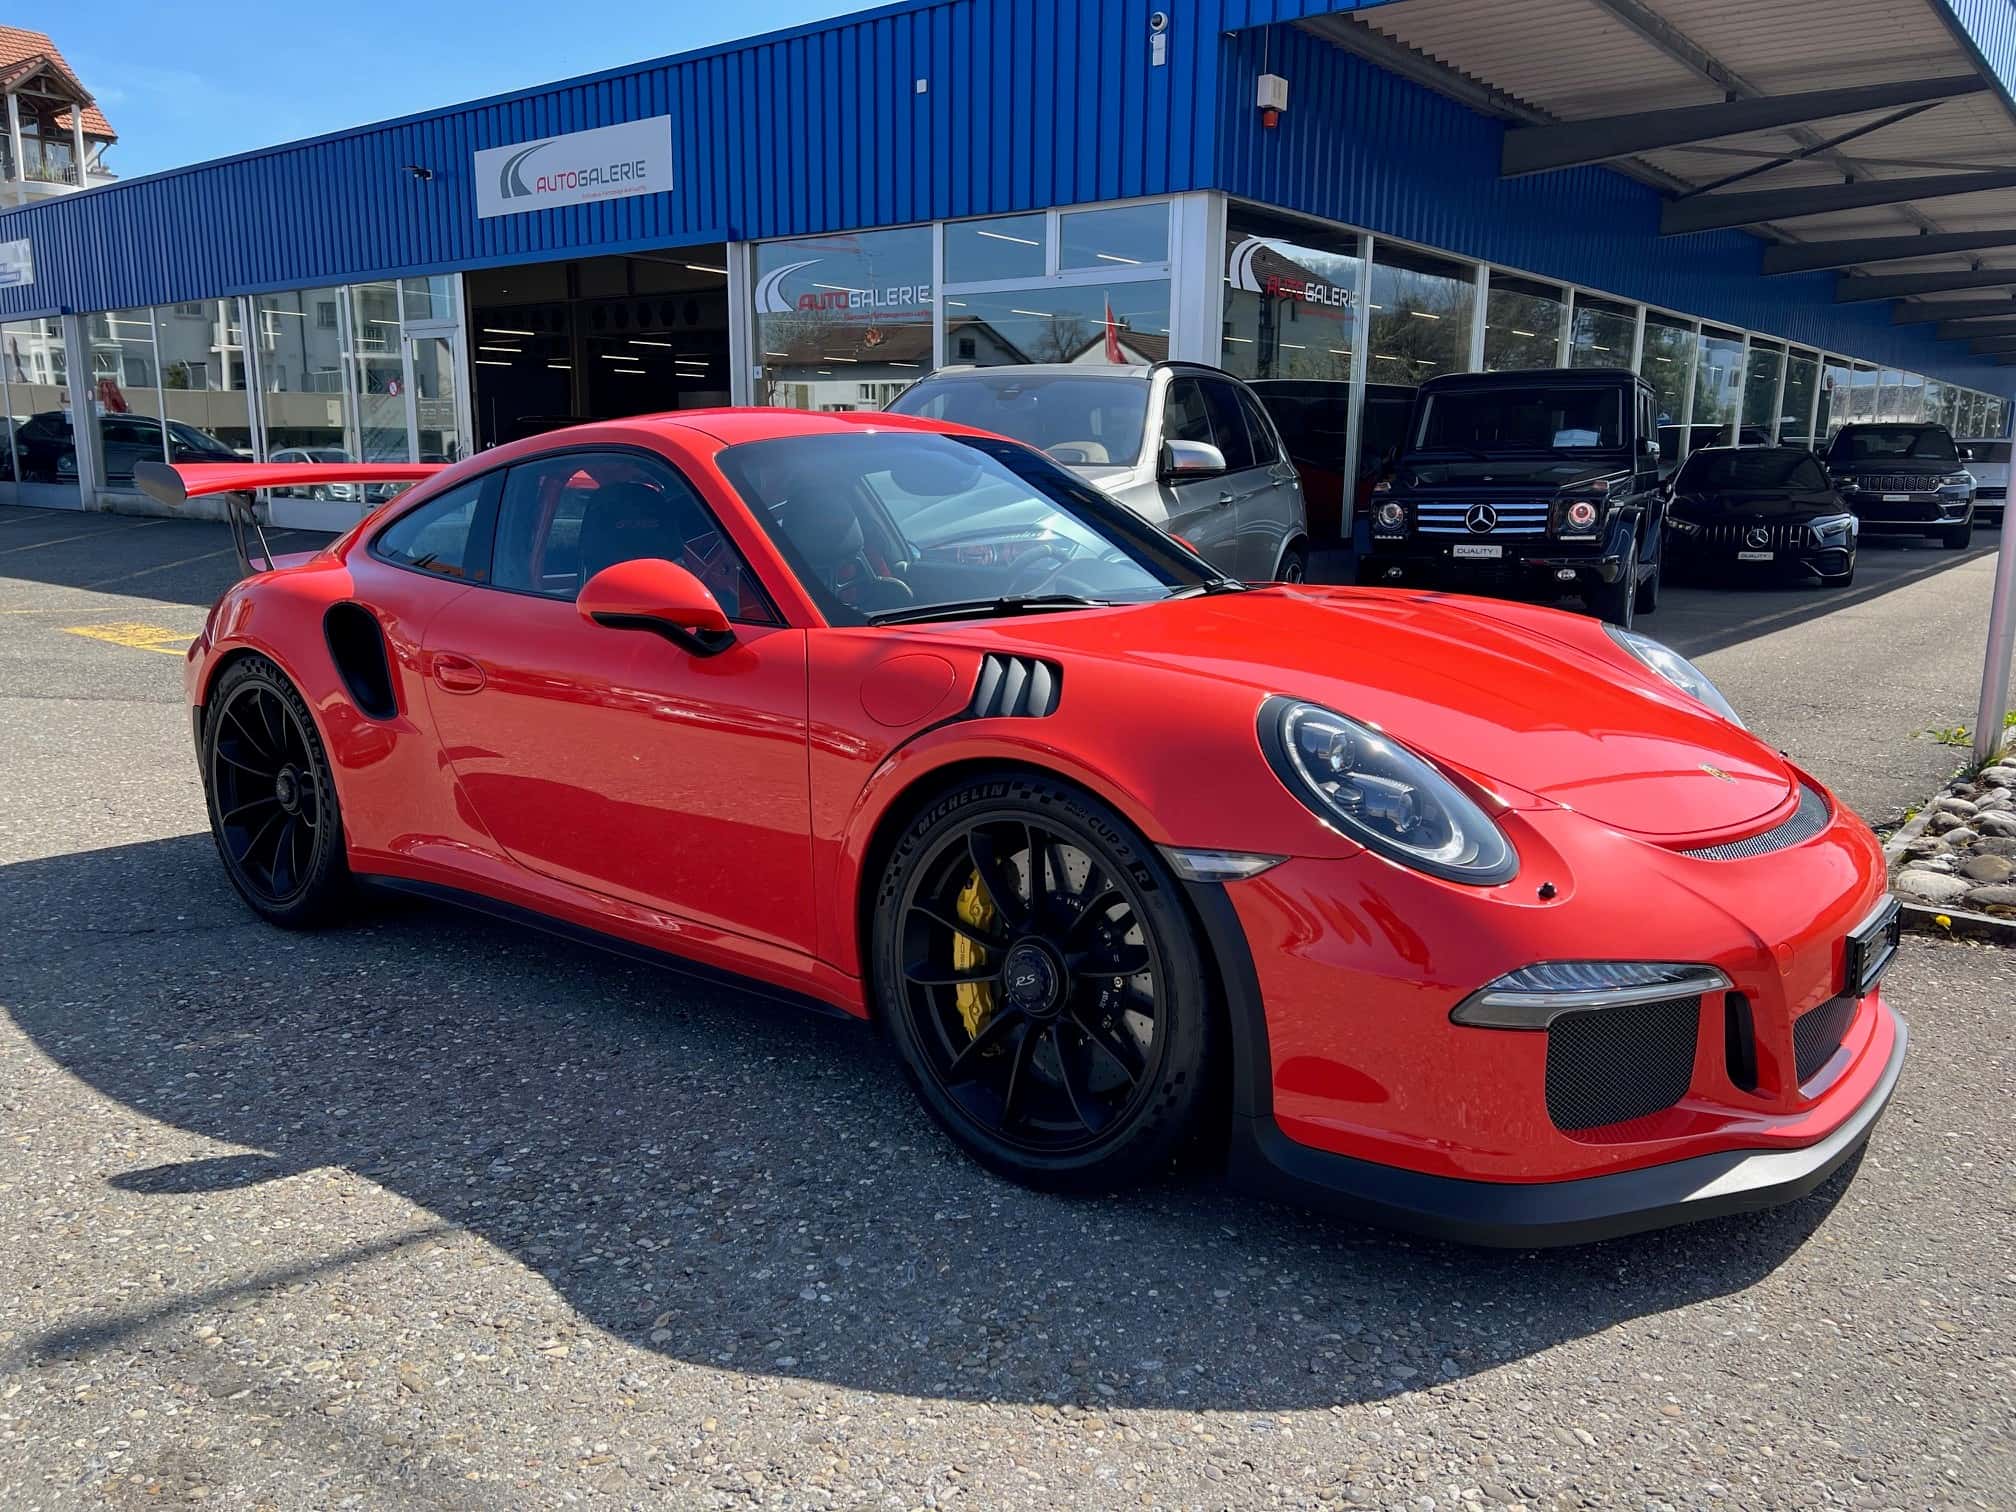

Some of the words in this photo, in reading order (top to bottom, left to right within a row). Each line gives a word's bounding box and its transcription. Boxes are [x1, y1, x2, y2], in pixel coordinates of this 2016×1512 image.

[536, 159, 646, 193] AUTOGALERIE
[799, 285, 930, 312] AUTOGALERIE
[918, 783, 1005, 834] MICHELIN
[1088, 817, 1119, 844] CUP
[1116, 845, 1130, 857] 2
[1016, 974, 1035, 988] RS
